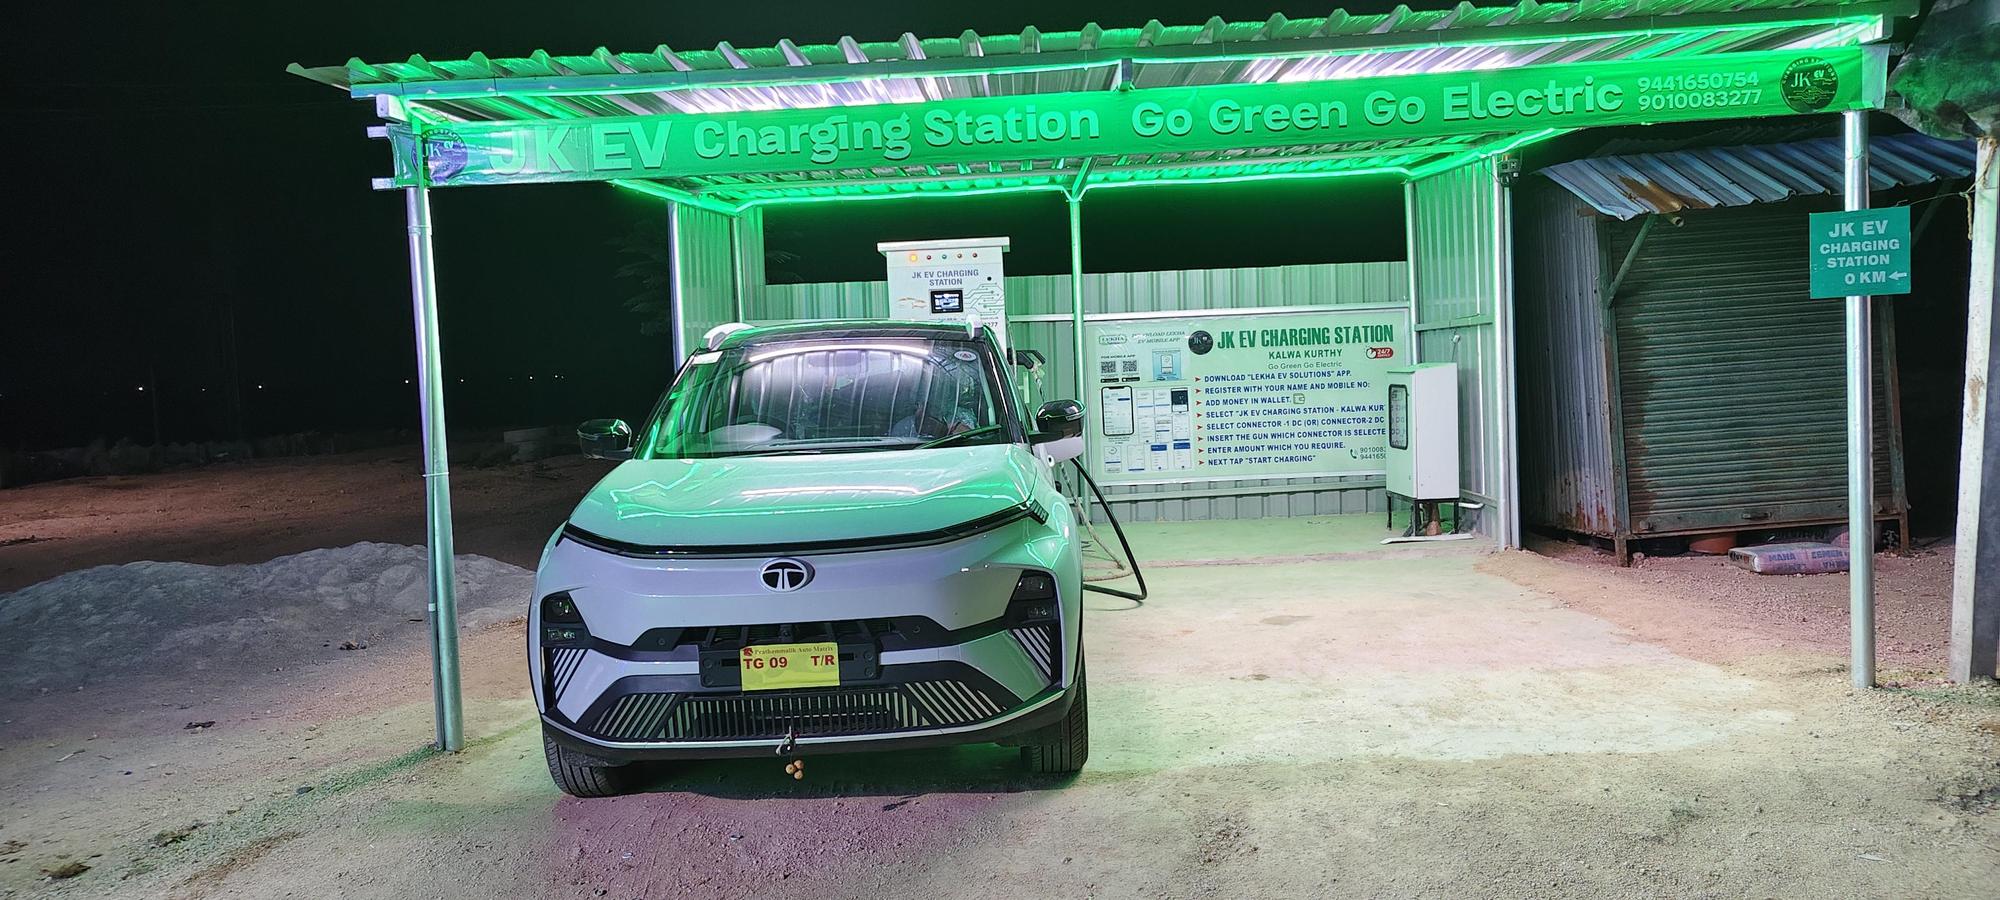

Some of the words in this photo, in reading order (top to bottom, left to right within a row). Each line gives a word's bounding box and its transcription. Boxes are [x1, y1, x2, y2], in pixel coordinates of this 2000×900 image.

[1638, 71, 1759, 93] 9441650754
[1790, 72, 1811, 87] JK
[1638, 89, 1762, 111] 9010083277
[489, 126, 574, 175] JK
[591, 121, 673, 171] EV
[693, 112, 912, 163] Charging
[924, 104, 1099, 146] Station
[1131, 105, 1193, 136] Go
[1208, 98, 1347, 134] Green
[1363, 90, 1425, 124] Go
[1443, 76, 1624, 121] Electric
[1829, 223, 1855, 238] JK
[1862, 219, 1888, 235] EV
[1820, 238, 1900, 255] CHARGING
[1827, 254, 1890, 268] STATION
[937, 268, 979, 278] CHARGING
[1860, 271, 1886, 284] KM
[929, 278, 963, 286] STATION
[1217, 331, 1235, 349] JK
[1239, 330, 1257, 348] EV
[1261, 326, 1338, 347] CHARGING
[1339, 324, 1394, 344] STATION
[1268, 350, 1301, 360] KALWA
[1304, 348, 1342, 358] KURTHY
[1268, 362, 1278, 370] Go
[1304, 361, 1314, 369] Go
[1316, 360, 1343, 368] Electric
[1204, 374, 1246, 383] DOWNLOAD
[1247, 372, 1276, 381] "LEKHA
[1278, 372, 1287, 380] EV
[1289, 370, 1335, 379] SOLUTIONS"
[1337, 369, 1352, 377] APP.
[1205, 386, 1242, 394] REGISTER
[1243, 385, 1263, 393] WITH
[1264, 384, 1285, 392] YOUR
[1287, 383, 1308, 391] NAME
[1310, 382, 1326, 390] AND
[1327, 381, 1355, 389] MOBILE
[1260, 396, 1292, 404] WALLET.
[1206, 411, 1234, 419] SELECT
[1236, 409, 1249, 417] "JK
[1262, 407, 1301, 416] CHARGING
[1303, 406, 1335, 414] STATION
[1341, 404, 1367, 413] KALWA
[1368, 404, 1386, 412] KUR
[1206, 423, 1234, 431] SELECT
[1236, 421, 1281, 429] CONNECTOR
[1304, 419, 1319, 427] (OR)
[1321, 417, 1373, 426] CONNECTOR-2
[1375, 416, 1385, 424] DC
[1207, 434, 1234, 442] INSERT
[1236, 433, 1251, 441] THE
[1252, 432, 1269, 440] GUN
[1270, 431, 1295, 439] WHICH
[1297, 430, 1343, 438] CONNECTOR
[1207, 446, 1232, 454] ENTER
[1233, 445, 1265, 453] AMOUNT
[1311, 442, 1346, 450] REQUIRE.
[1208, 458, 1228, 466] NEXT
[1230, 457, 1244, 465] TAP
[1245, 456, 1272, 464] "START
[1274, 454, 1316, 463] CHARGING"
[1769, 551, 1796, 562] MAHA
[743, 658, 764, 669] TG
[769, 656, 788, 668] 09
[811, 654, 835, 666] T/R
